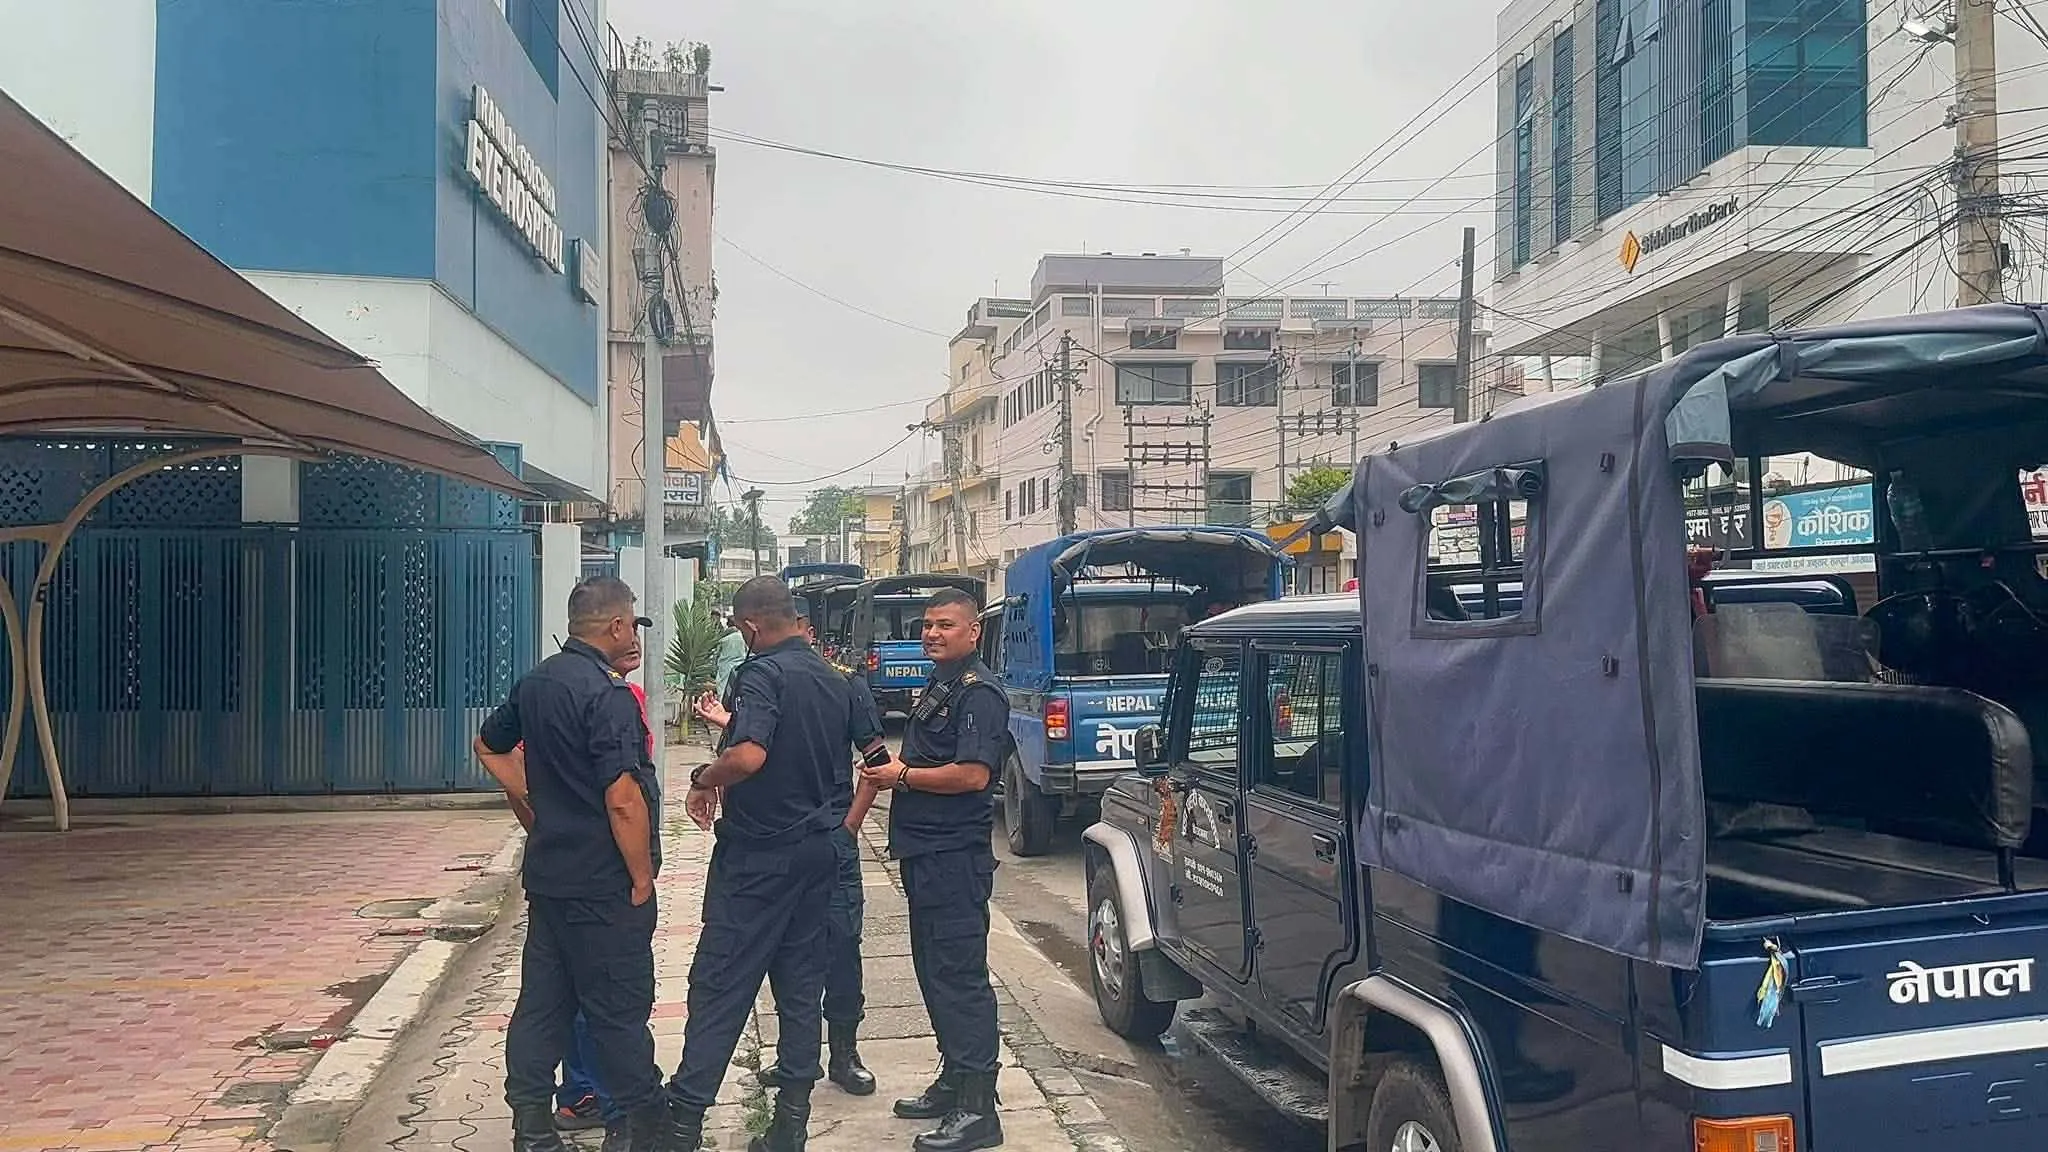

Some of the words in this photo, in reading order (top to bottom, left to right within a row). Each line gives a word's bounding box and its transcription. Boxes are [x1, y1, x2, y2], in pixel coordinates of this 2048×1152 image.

[467, 120, 502, 207] EYE
[501, 164, 564, 274] HOSPITAL
[1797, 504, 1872, 537] कौशिक
[886, 666, 926, 678] NEPAL
[1106, 696, 1156, 712] NEPAL
[1886, 957, 2036, 1004] नेपाल
